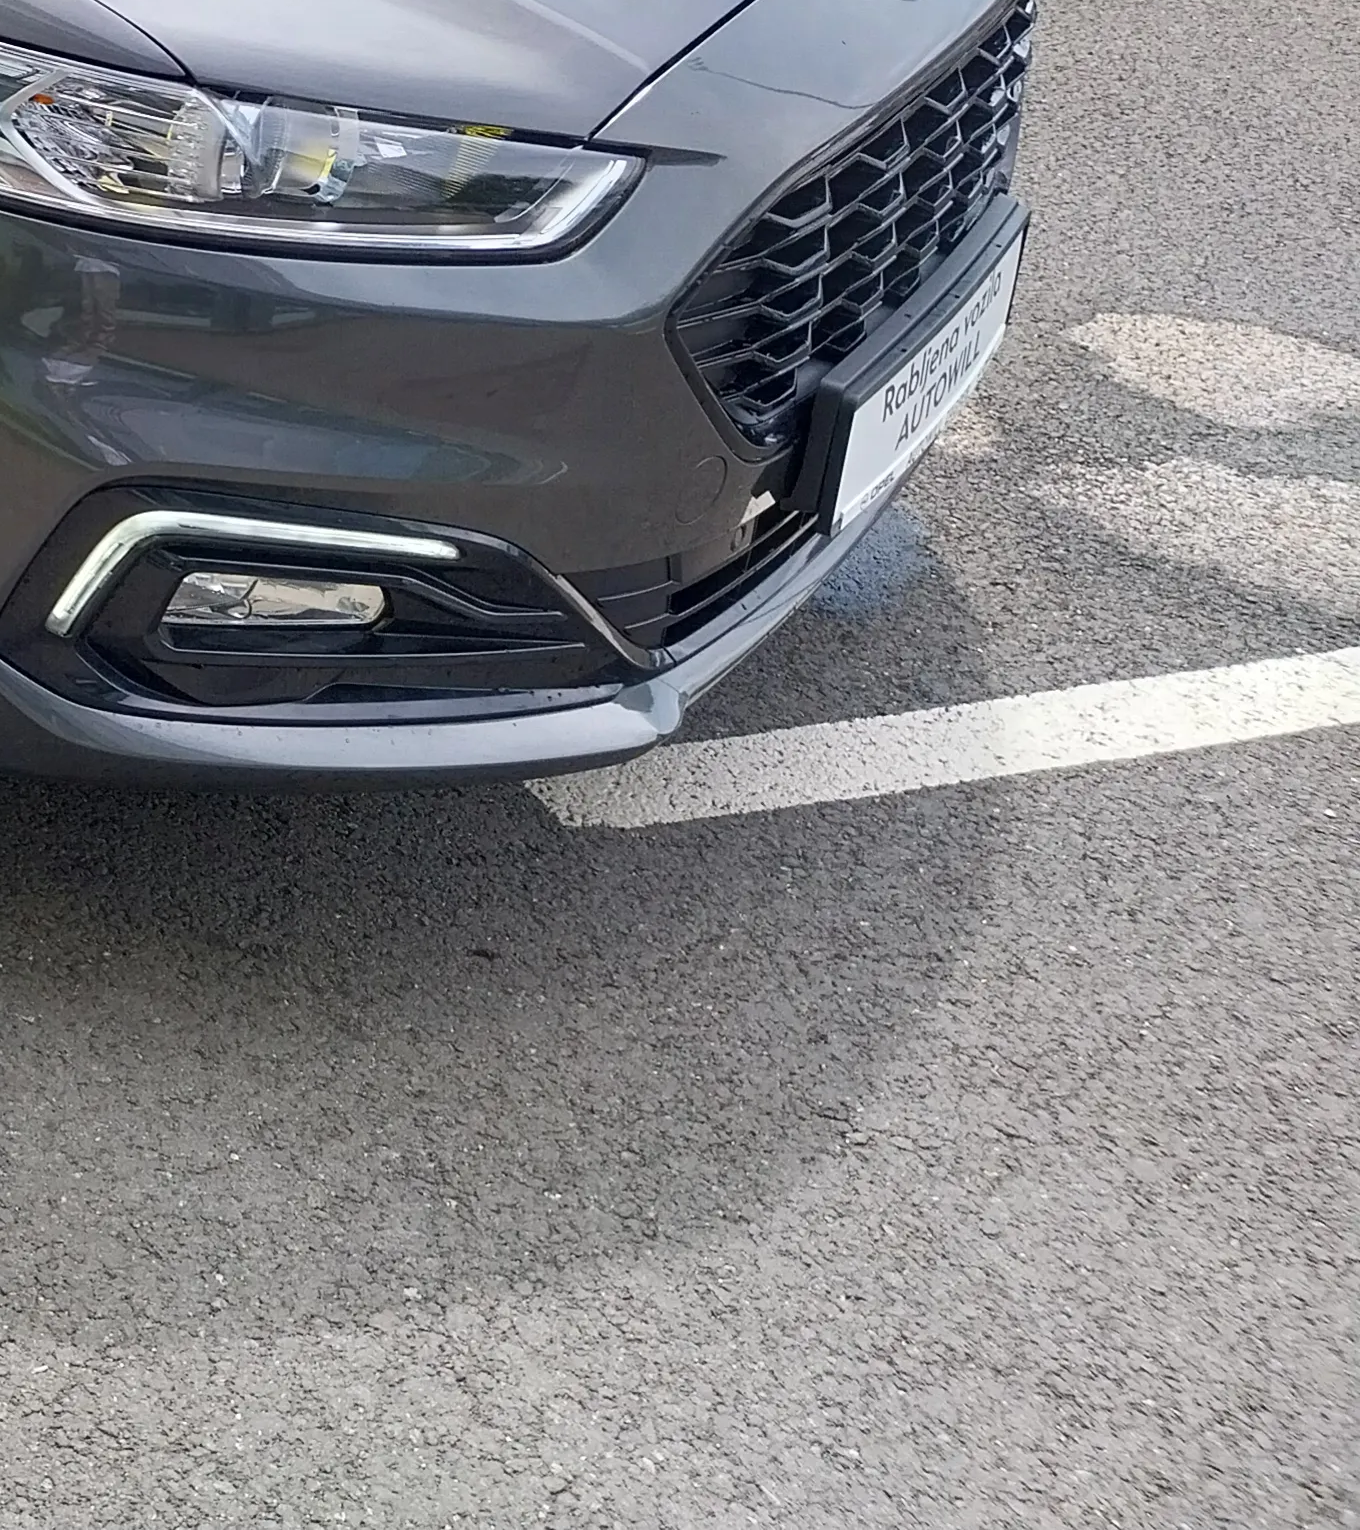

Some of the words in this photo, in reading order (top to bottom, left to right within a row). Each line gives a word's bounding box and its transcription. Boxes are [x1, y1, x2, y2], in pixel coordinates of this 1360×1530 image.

[882, 328, 959, 423] Rabljena
[963, 271, 1002, 336] vozila
[894, 330, 981, 451] AUTOWILL
